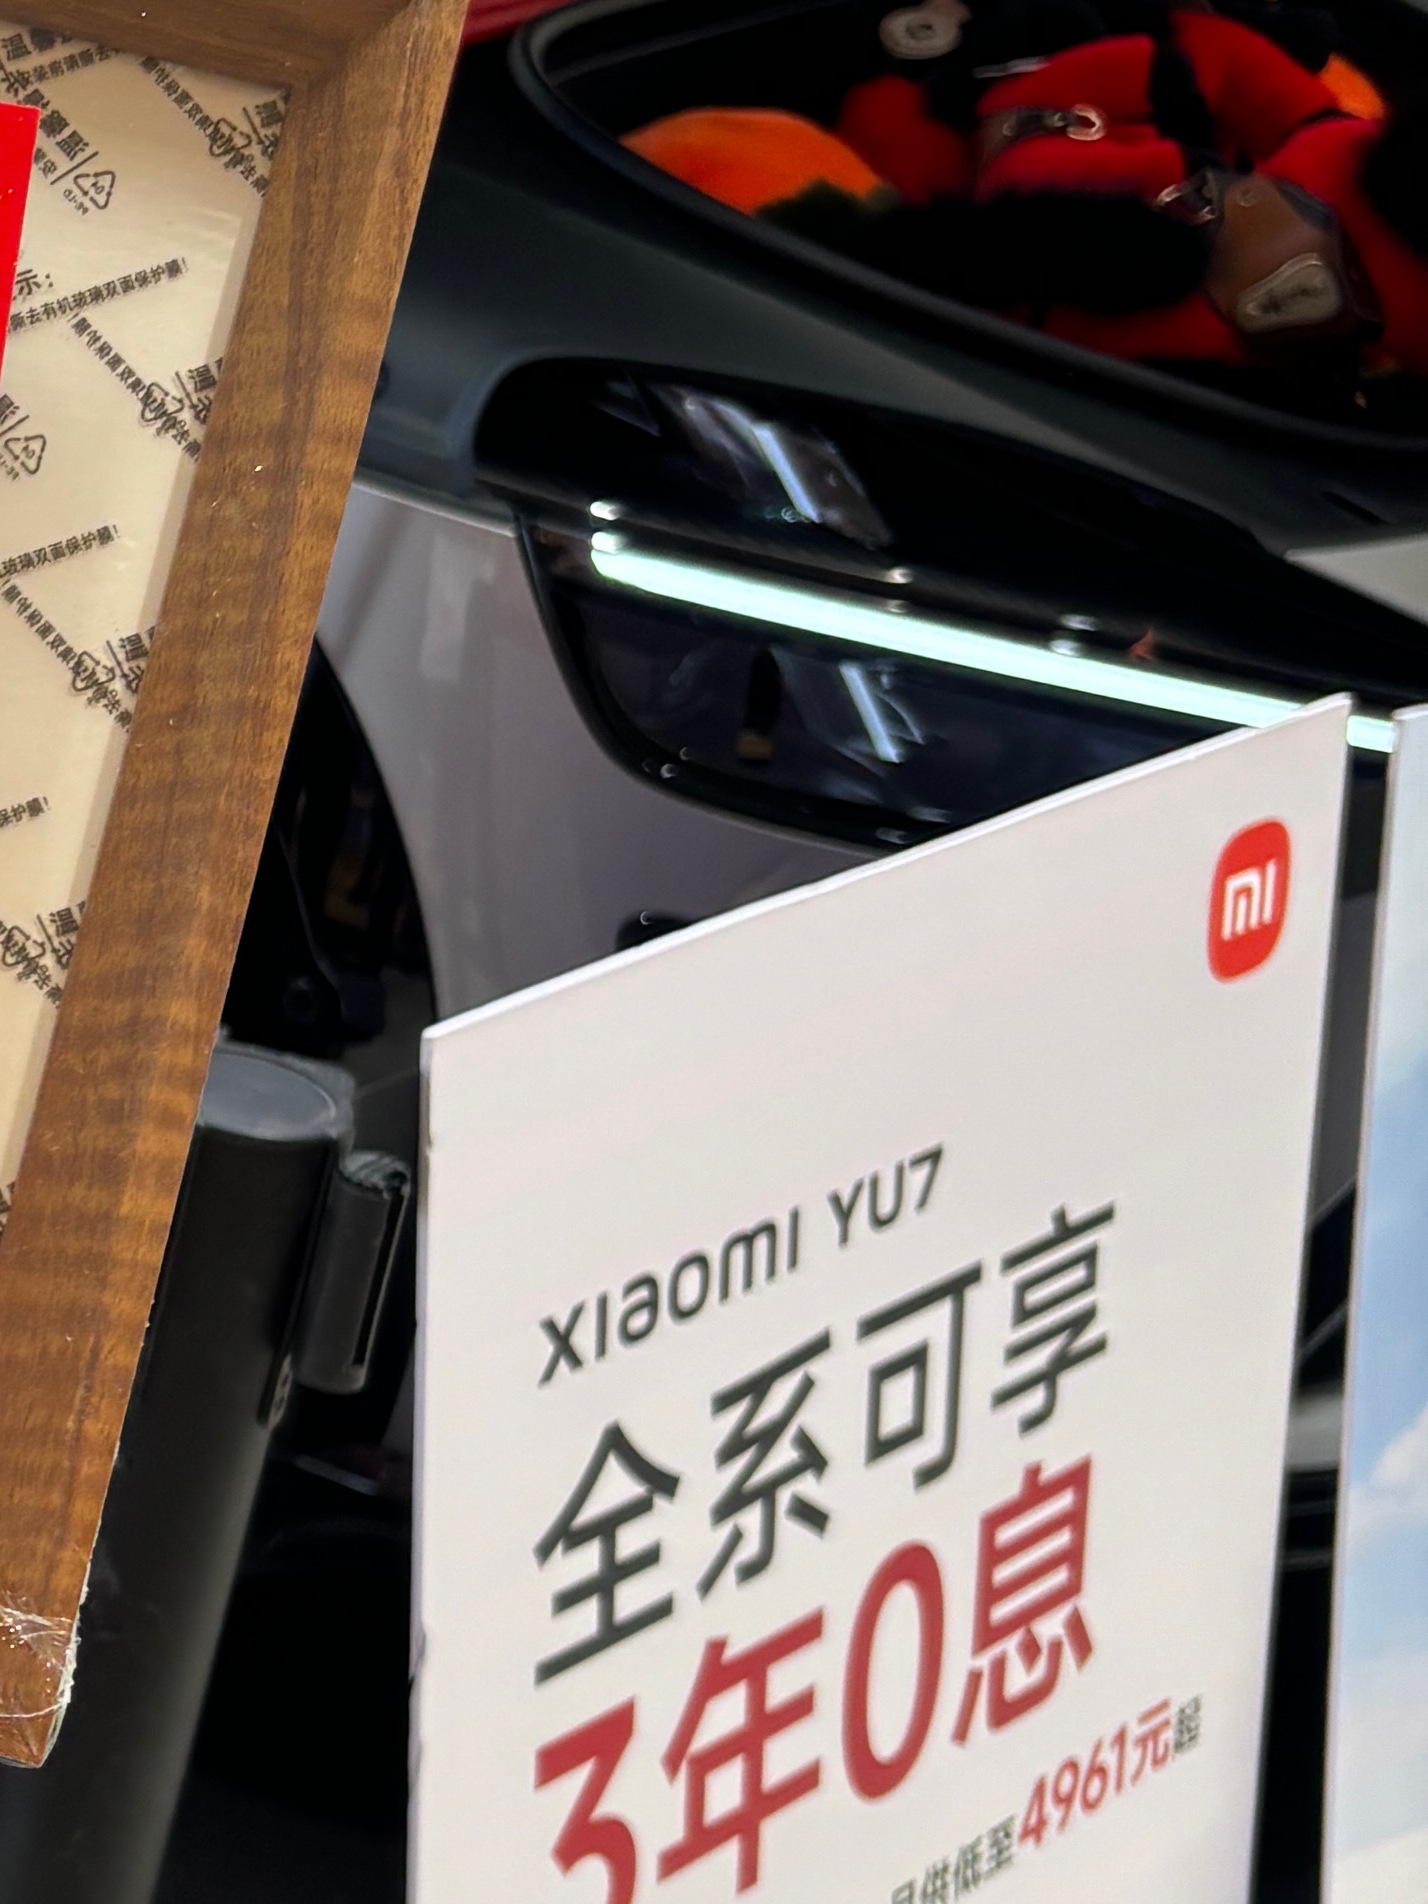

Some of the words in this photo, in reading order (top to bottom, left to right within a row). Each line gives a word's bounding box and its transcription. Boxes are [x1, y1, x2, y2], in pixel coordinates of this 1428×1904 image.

[828, 1141, 948, 1251] YU7
[532, 1199, 1117, 1689] 全系可享
